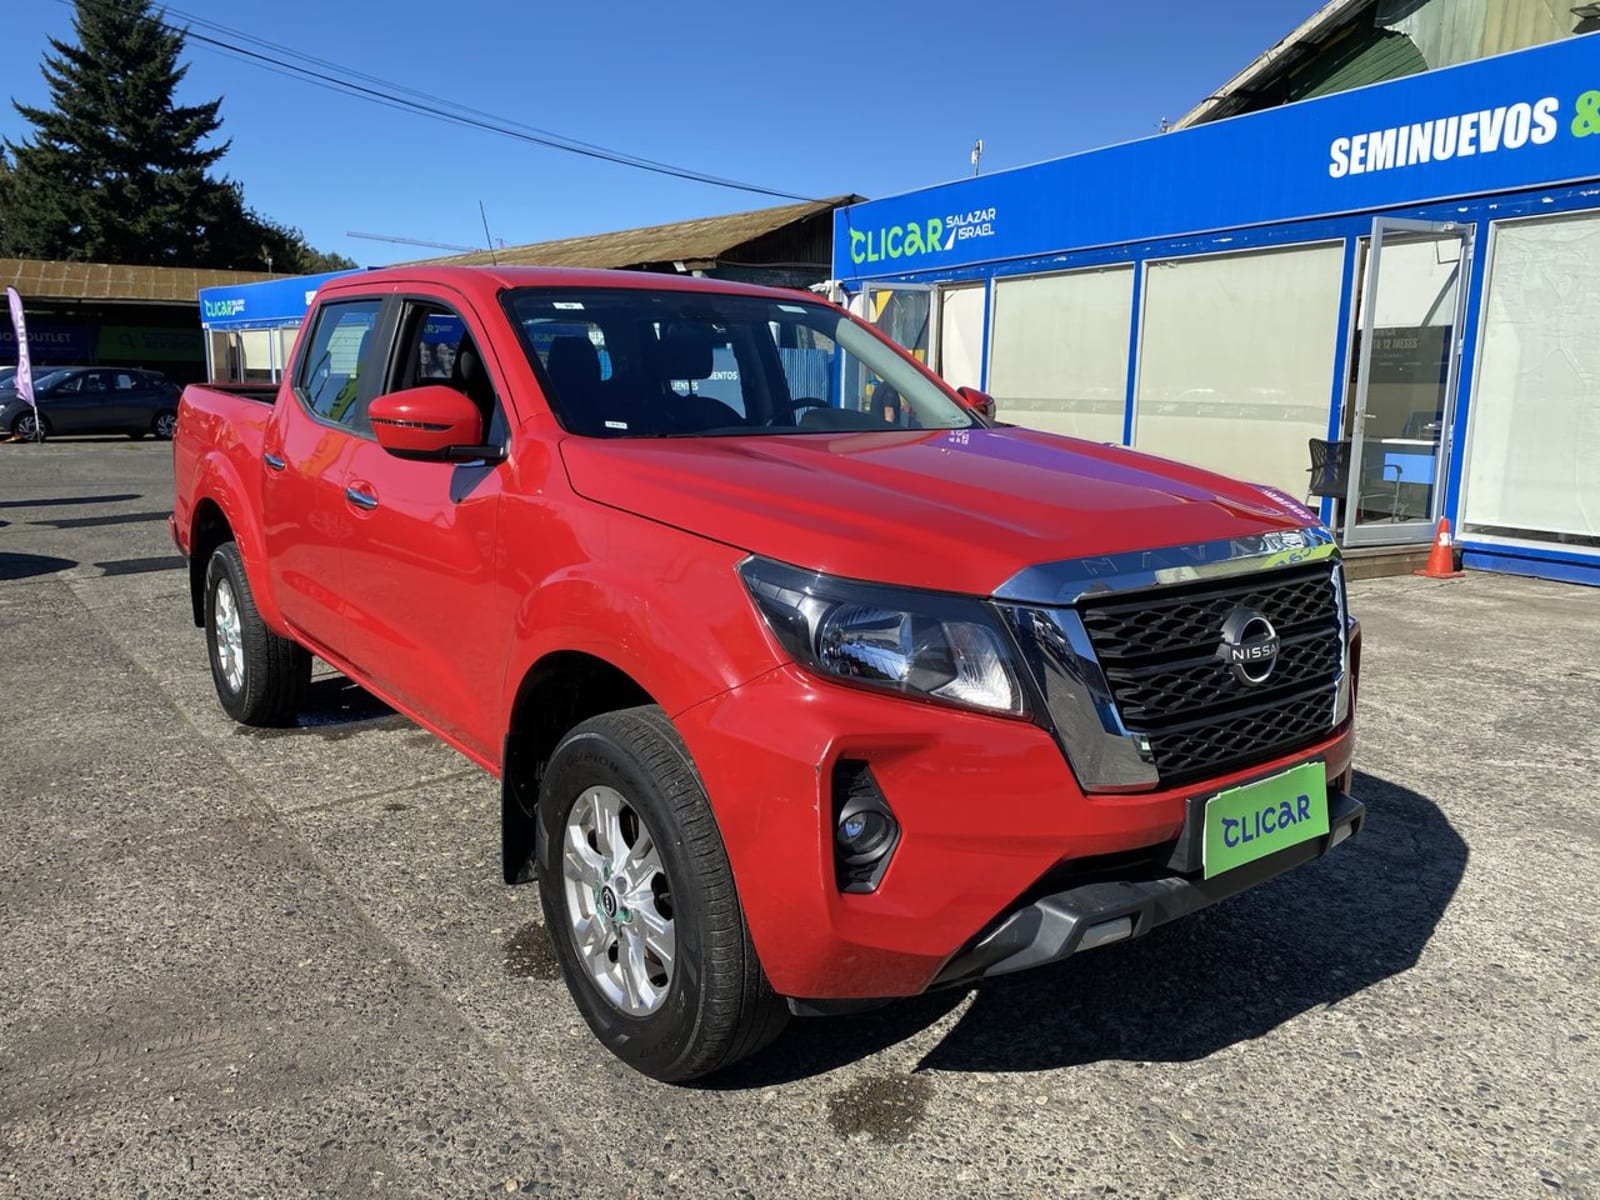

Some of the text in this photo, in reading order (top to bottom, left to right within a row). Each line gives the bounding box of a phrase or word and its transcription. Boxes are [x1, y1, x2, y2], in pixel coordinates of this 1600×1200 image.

[1329, 90, 1600, 178] SEMINUEVOS &
[946, 208, 996, 228] SALAZAR
[958, 223, 995, 240] ISRAEL
[849, 218, 943, 264] CLICAR
[1232, 644, 1279, 660] NISSA
[1222, 795, 1310, 847] CLICAR
